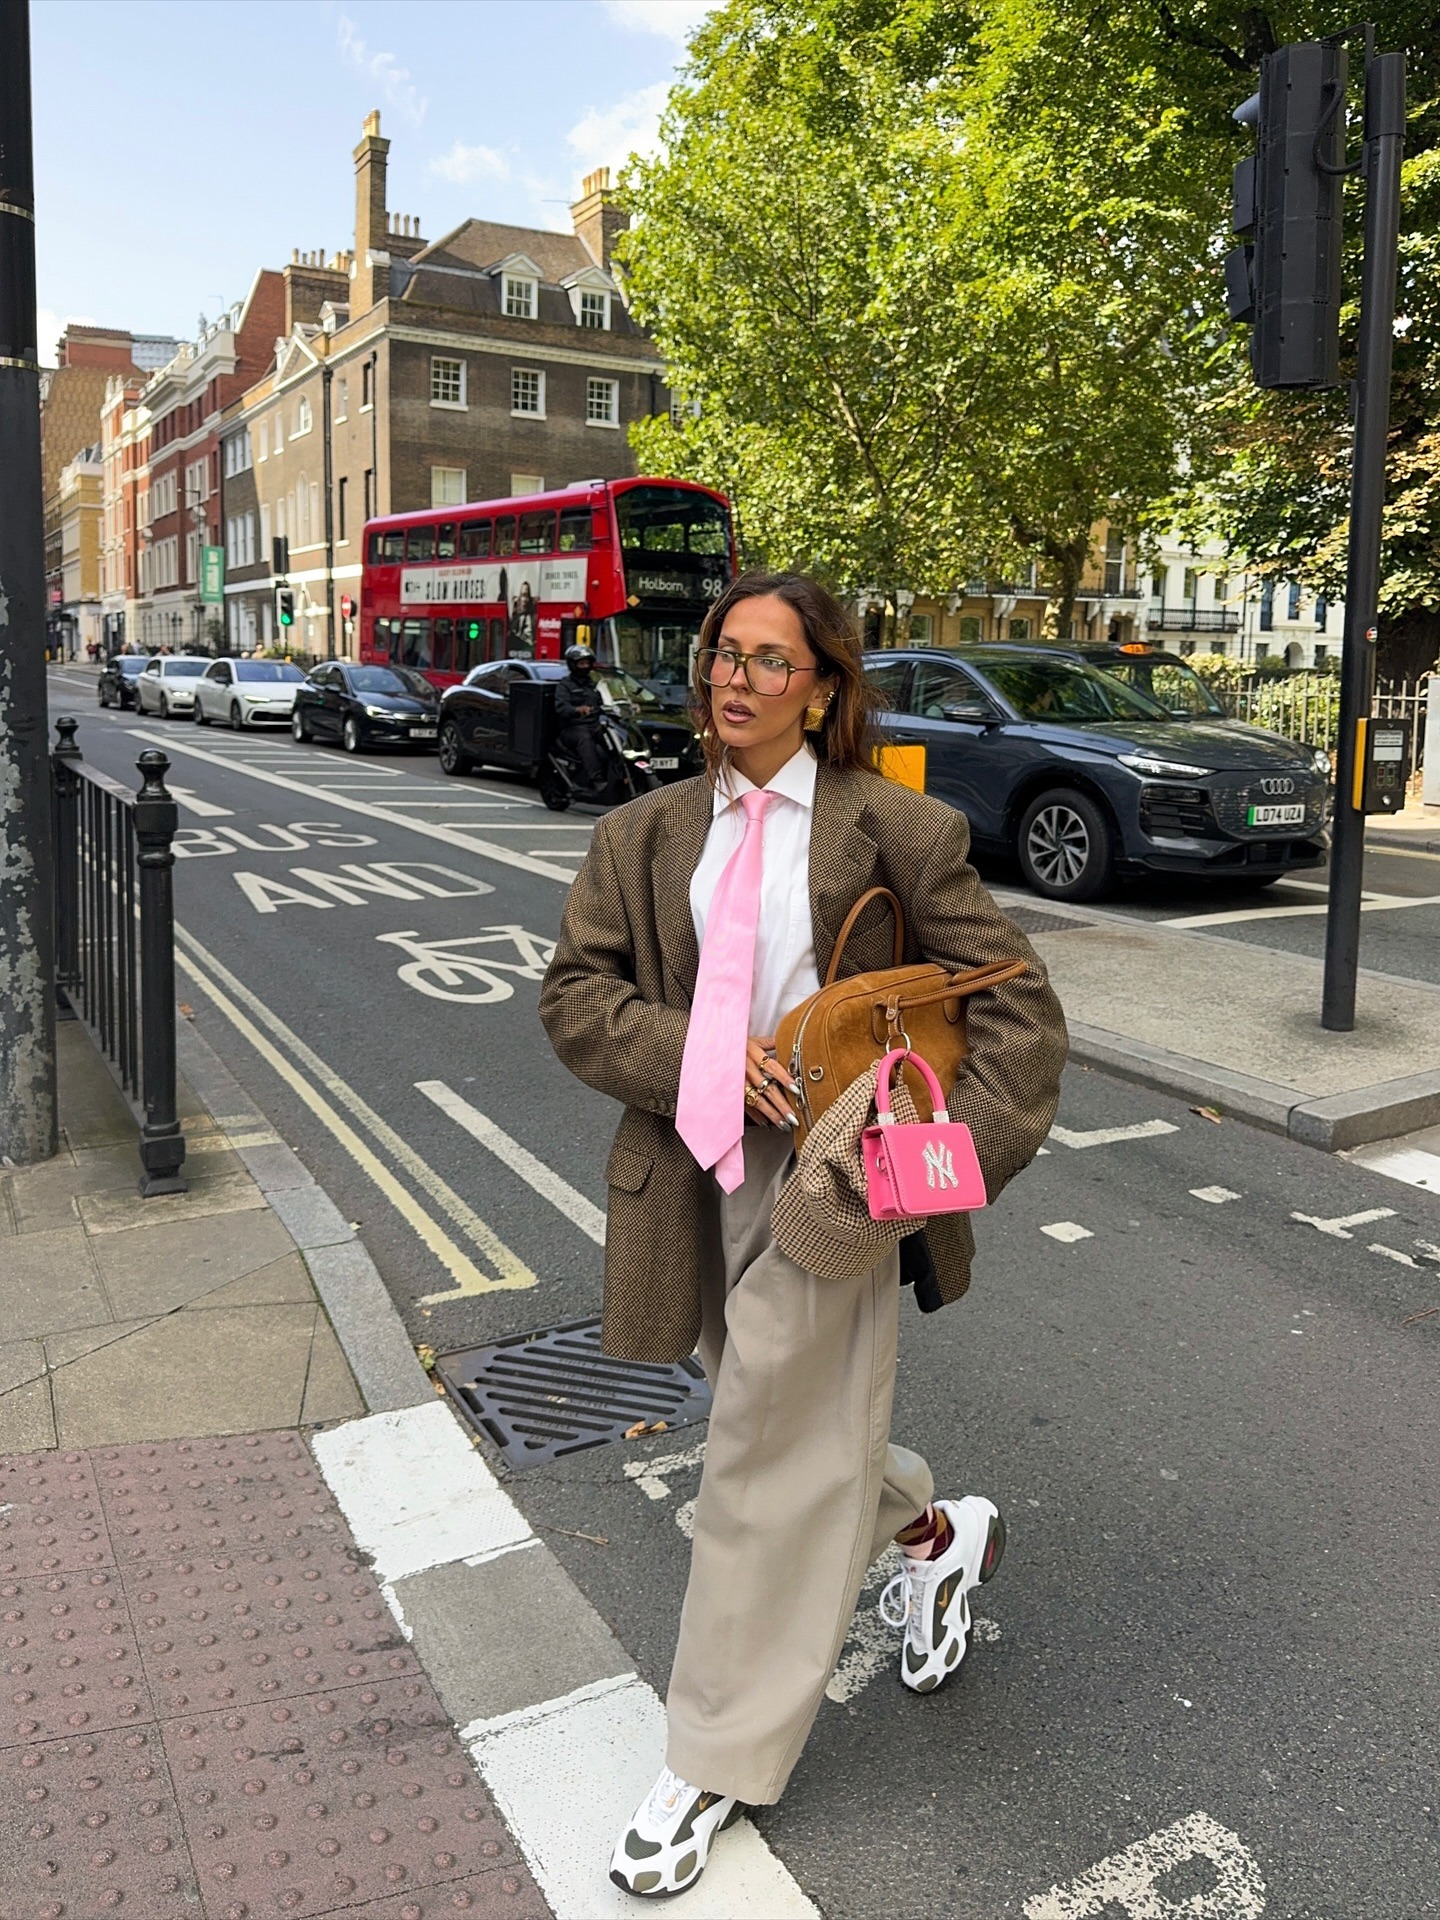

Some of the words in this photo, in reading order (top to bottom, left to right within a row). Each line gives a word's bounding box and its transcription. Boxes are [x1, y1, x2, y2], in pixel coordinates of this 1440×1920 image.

[638, 576, 684, 592] Holborn
[702, 577, 723, 598] 98
[1284, 807, 1301, 821] UZA
[170, 822, 379, 859] BUS
[232, 862, 496, 913] AND
[921, 1140, 959, 1191] NY
